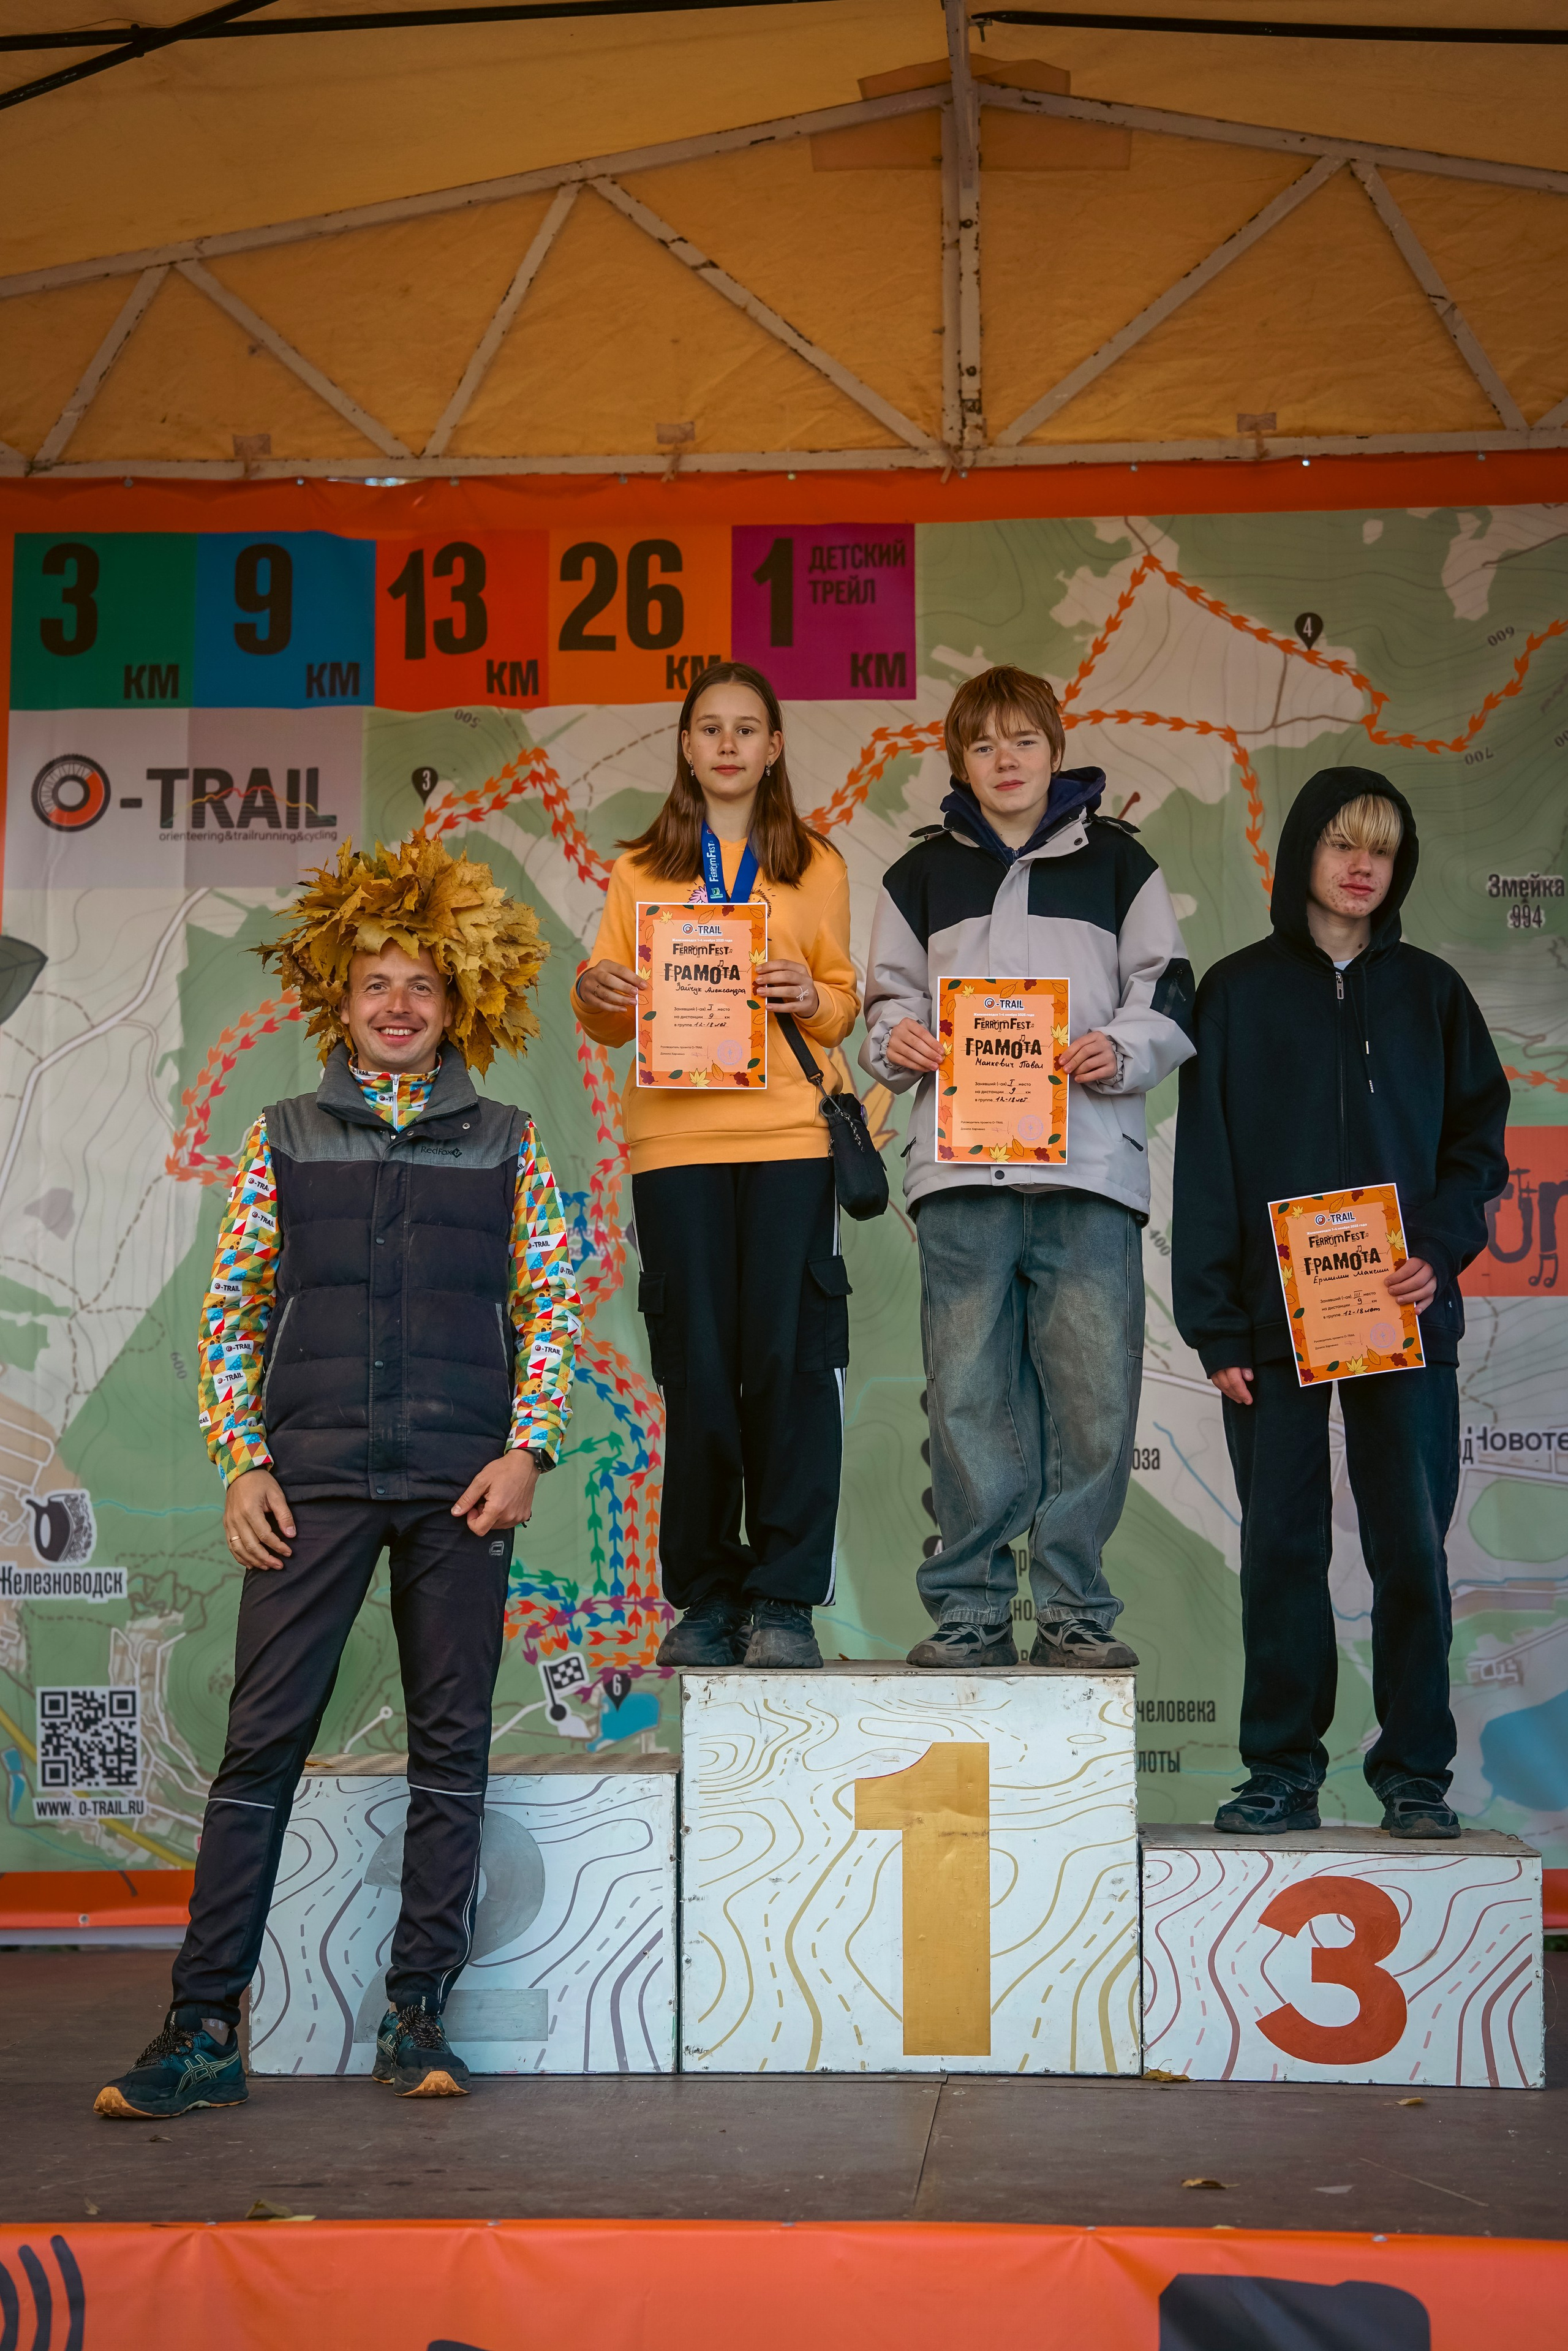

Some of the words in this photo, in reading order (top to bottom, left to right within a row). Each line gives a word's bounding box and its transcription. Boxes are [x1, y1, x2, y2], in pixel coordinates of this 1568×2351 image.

[809, 540, 906, 573] ДЕТСКИЙ
[40, 543, 100, 657] 3
[234, 543, 293, 655] 9
[387, 542, 488, 660] 13
[558, 539, 684, 651] 26
[752, 538, 793, 647] 1
[809, 575, 876, 605] ТРЕЙЛ
[1303, 617, 1313, 637] 4
[306, 662, 360, 697] КМ
[486, 659, 539, 696] КМ
[851, 652, 906, 688] КМ
[124, 665, 179, 700] КМ
[421, 770, 431, 790] 3
[31, 753, 337, 833] O-TRAIL
[159, 829, 337, 844] orienteering&trailrunning&cycling
[1488, 874, 1564, 898] Змейка
[1512, 904, 1542, 928] 994
[682, 923, 722, 934] O-TRAIL
[665, 963, 741, 984] ГРАМОТА
[984, 998, 1024, 1008] O-TRAIL
[965, 1038, 1042, 1059] ГРАМОТА
[421, 1146, 453, 1156] RedFox
[1315, 1212, 1355, 1225] O-TRAIL
[1303, 1248, 1381, 1275] ГРАМОТА
[214, 1283, 241, 1292] O-TRAIL
[226, 1343, 252, 1352] O-TRAIL
[535, 1345, 561, 1356] O-TRAIL
[217, 1372, 244, 1384] O-TRAIL
[0, 1566, 123, 1598] Железноводск
[613, 1674, 622, 1696] 6
[1136, 1700, 1216, 1723] человека
[37, 1802, 75, 1816] WWW.
[79, 1800, 145, 1816] O-TRAIL.RU
[854, 1742, 991, 2056] 1
[354, 1807, 548, 2043] 2
[1256, 1875, 1408, 2065] 3
